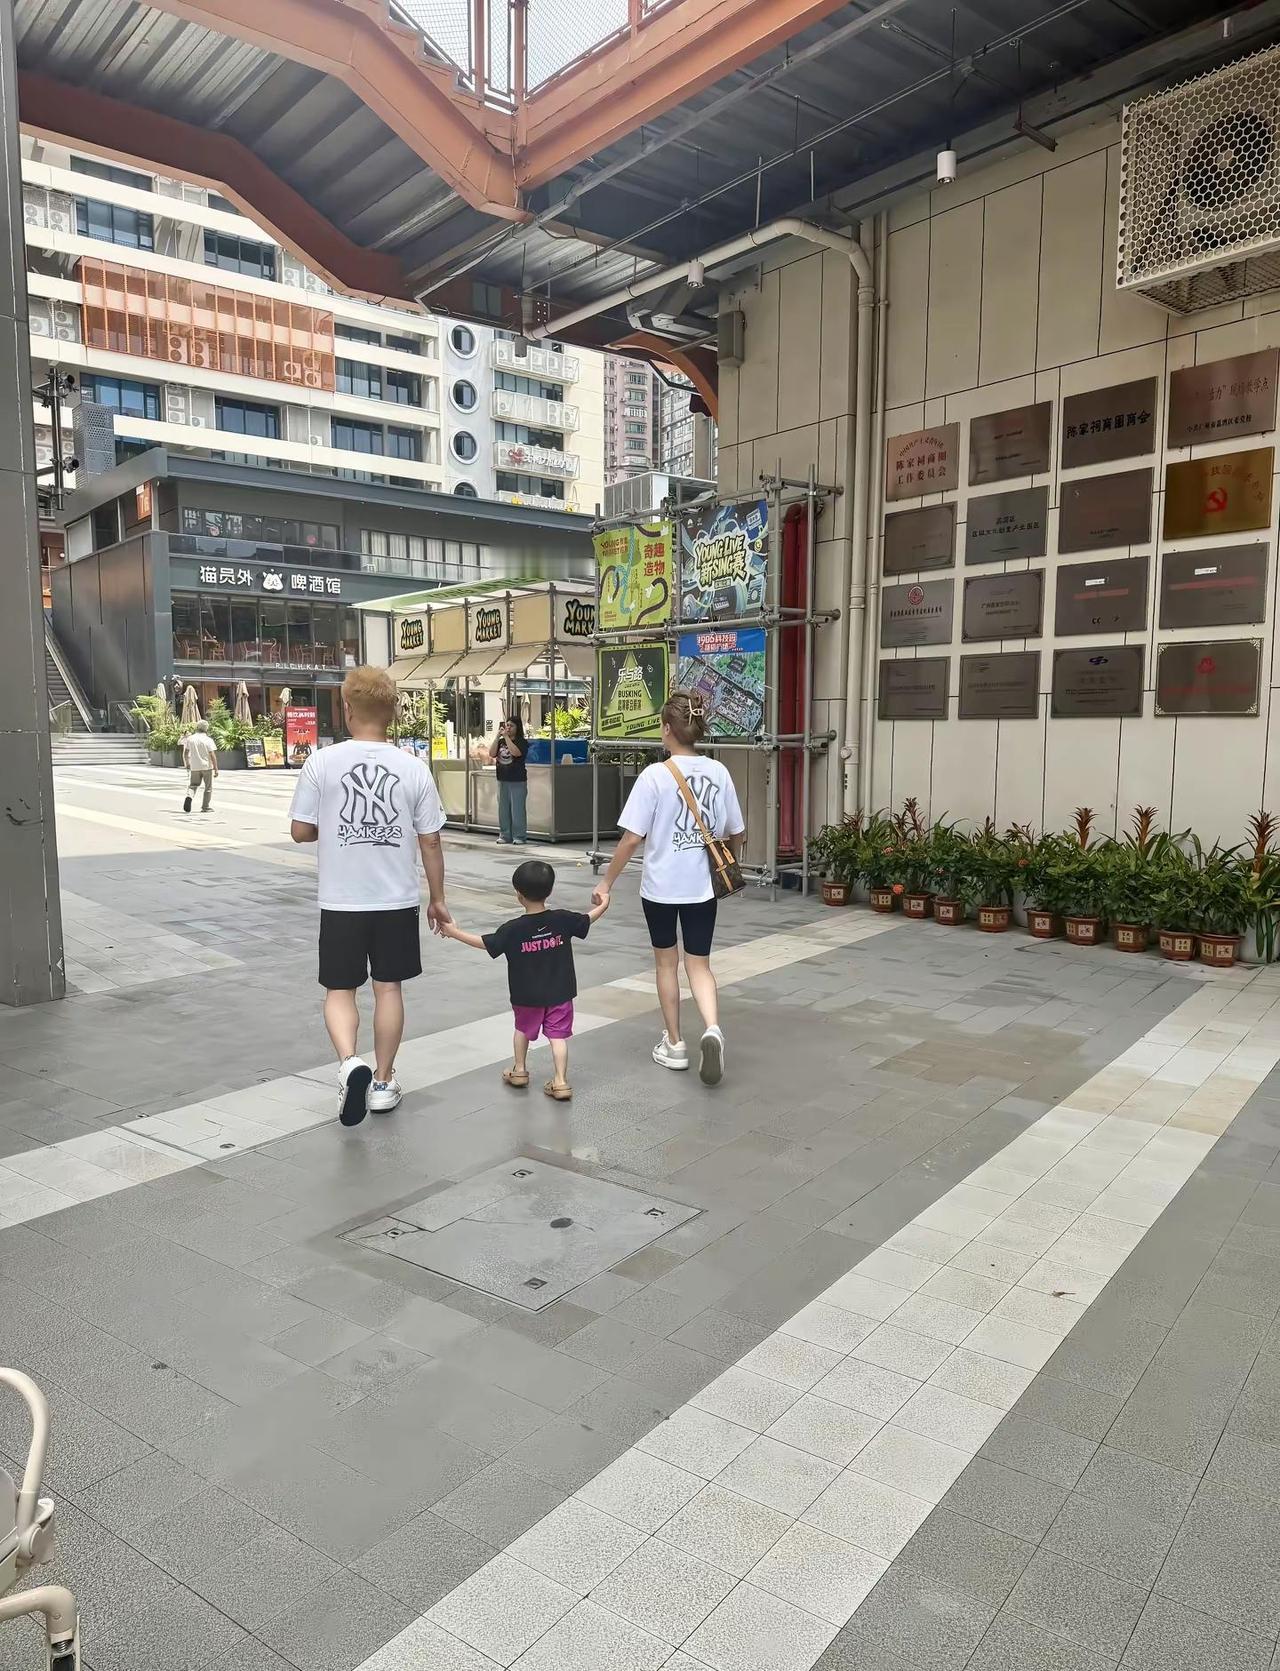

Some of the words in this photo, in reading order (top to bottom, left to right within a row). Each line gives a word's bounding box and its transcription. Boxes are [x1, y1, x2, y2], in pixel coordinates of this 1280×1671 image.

[644, 543, 665, 559] 奇趣
[695, 539, 724, 569] YOUNG
[724, 534, 745, 556] LIVE
[644, 560, 665, 577] 造物
[200, 566, 253, 586] 猫员外
[291, 574, 341, 594] 啤酒馆
[476, 608, 500, 628] YOUNG
[401, 619, 422, 636] YOUNG
[476, 622, 502, 642] MARKET
[564, 618, 595, 636] MARK
[401, 632, 423, 649] MARKET
[618, 689, 642, 698] BUSKING
[338, 824, 402, 841] YANKEES
[673, 831, 717, 847] YANK
[521, 939, 542, 953] JUST
[543, 937, 556, 950] DO
